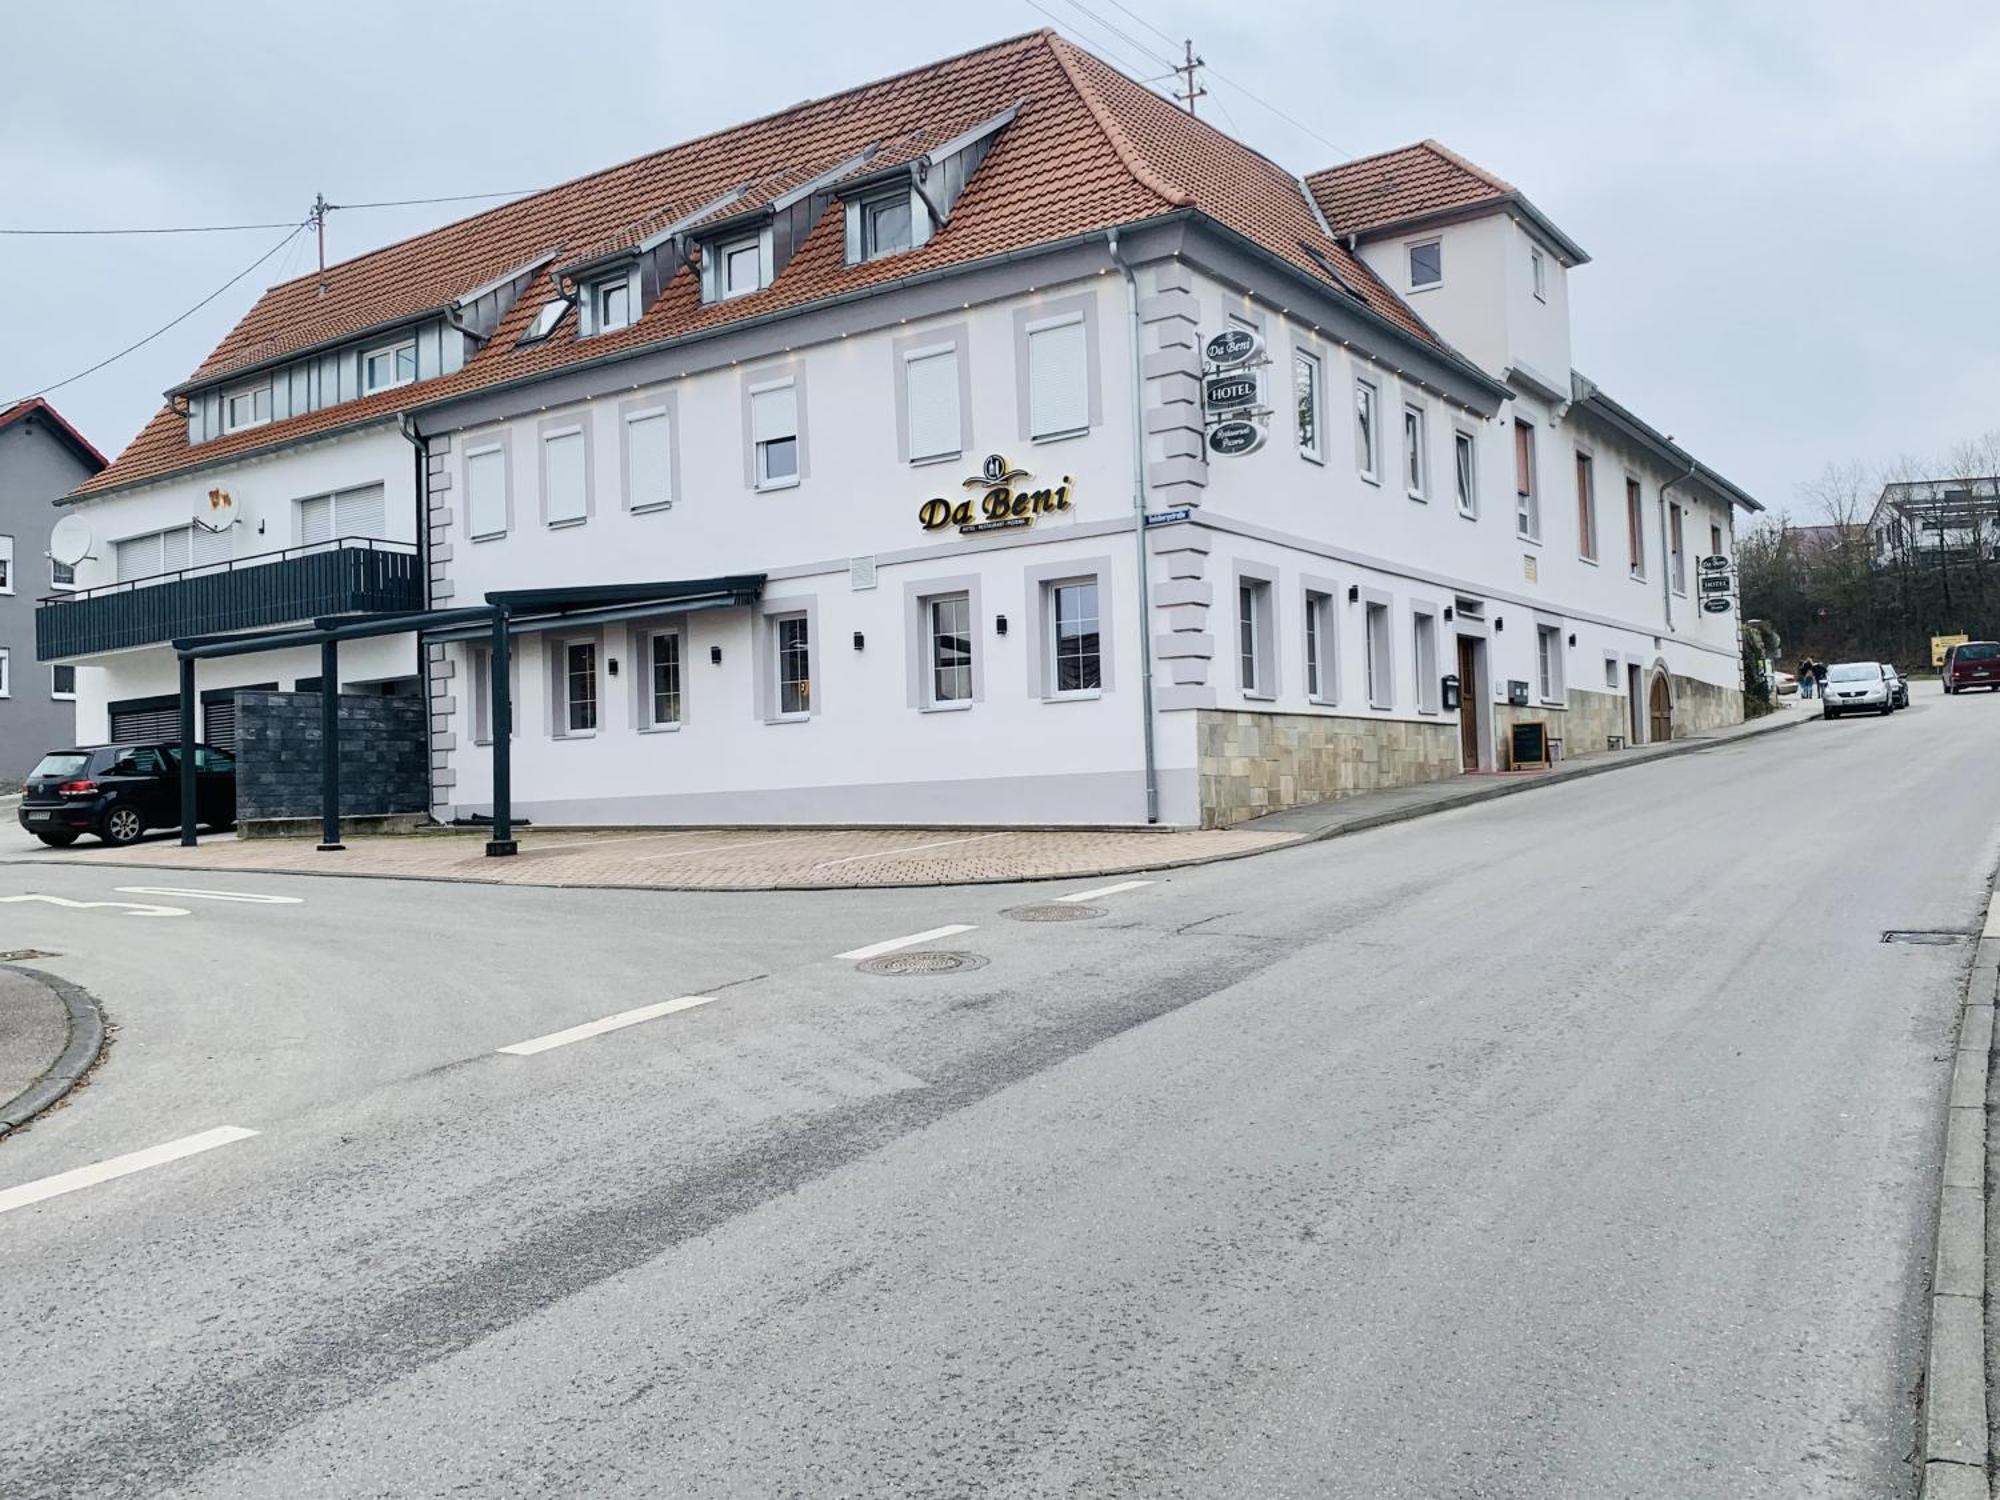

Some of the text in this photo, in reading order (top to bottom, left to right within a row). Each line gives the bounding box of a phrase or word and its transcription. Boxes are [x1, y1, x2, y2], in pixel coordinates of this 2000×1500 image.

[1208, 336, 1250, 357] Da Beni
[1211, 383, 1252, 401] HOTEL
[919, 475, 1072, 530] Da Beni
